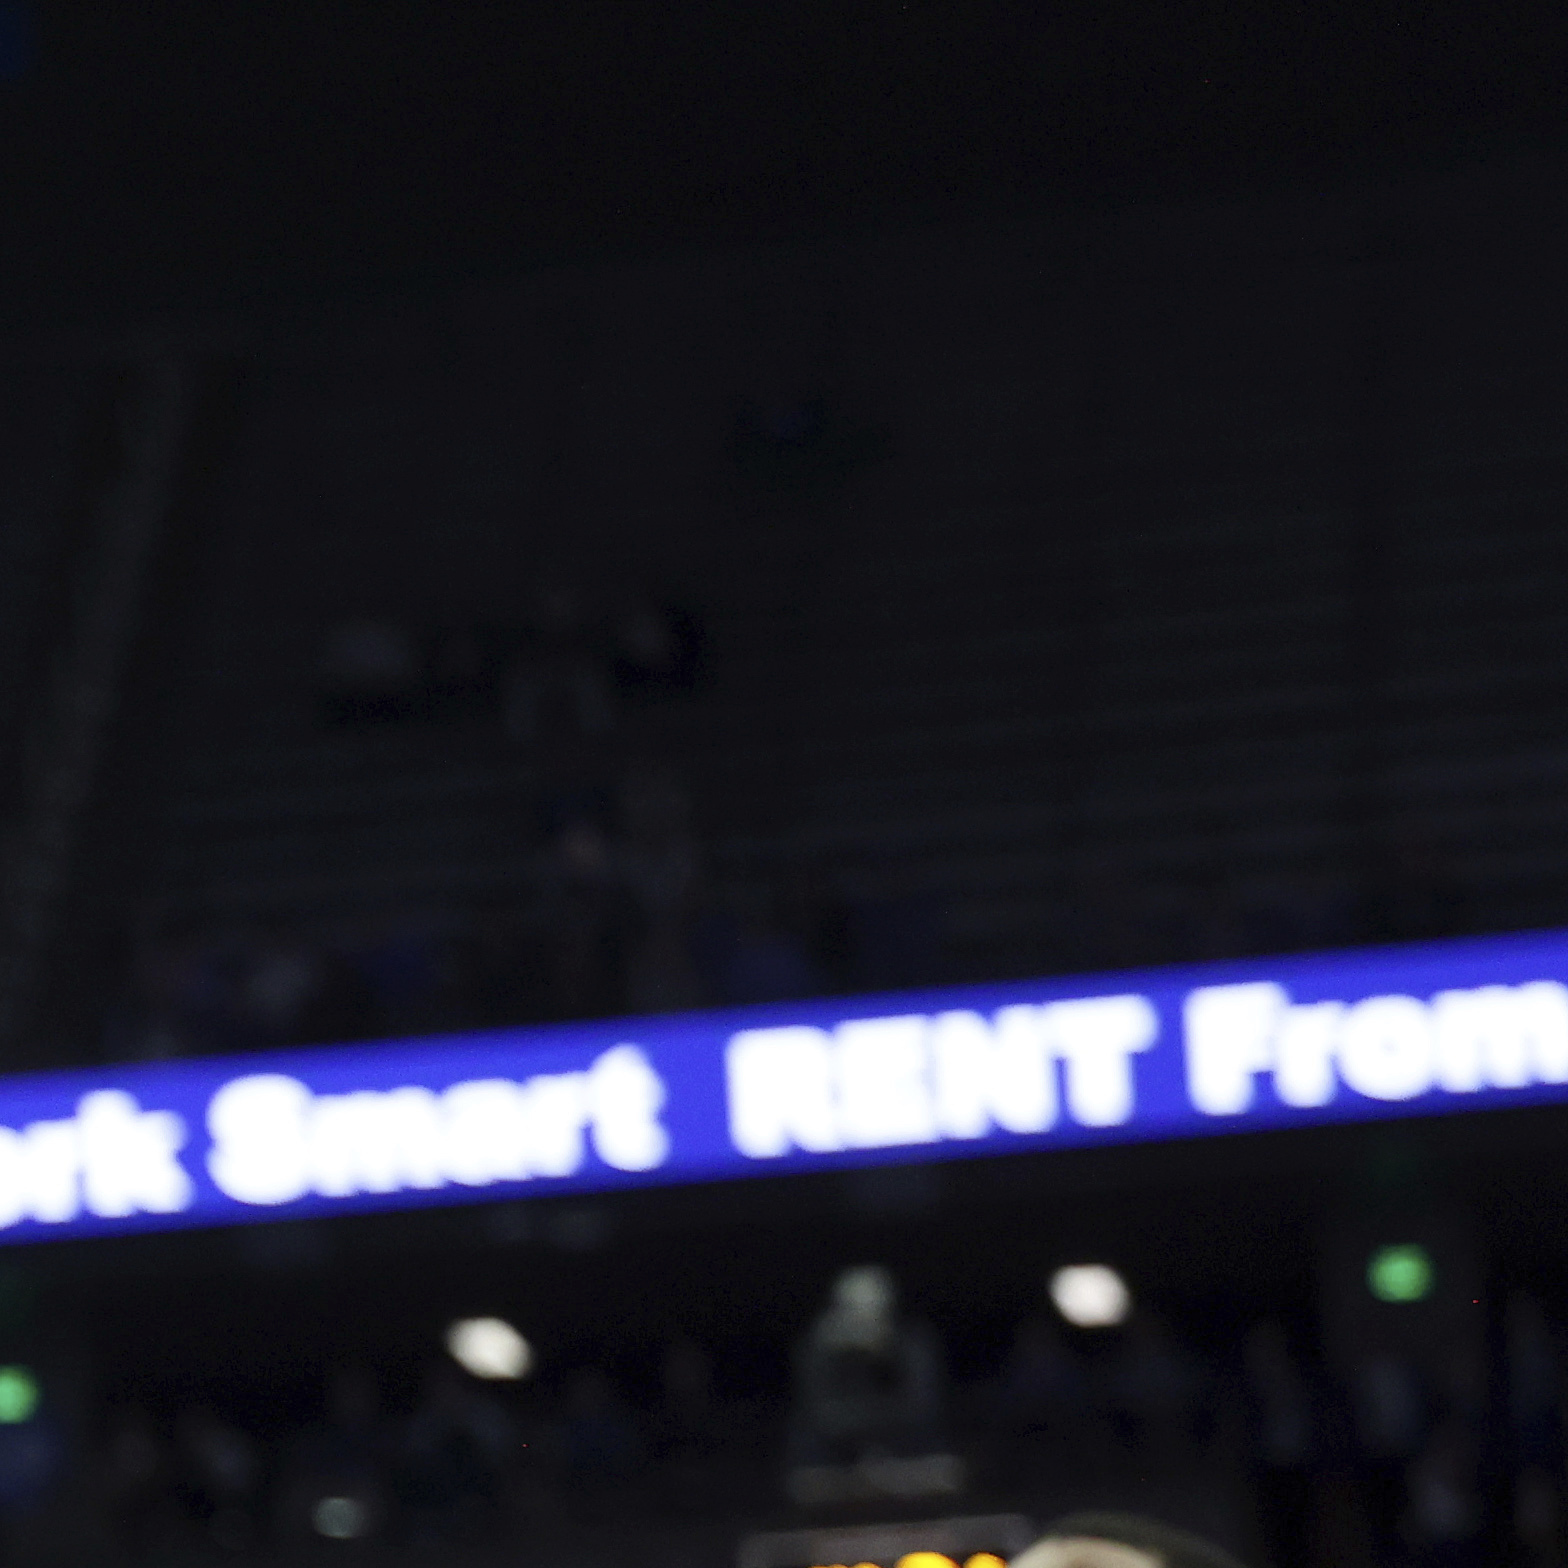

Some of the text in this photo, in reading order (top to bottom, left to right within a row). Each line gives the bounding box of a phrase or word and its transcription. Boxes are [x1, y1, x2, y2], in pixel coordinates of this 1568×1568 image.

[207, 1042, 670, 1206] Smart
[725, 993, 1160, 1160] RENT
[1182, 980, 1568, 1117] From
